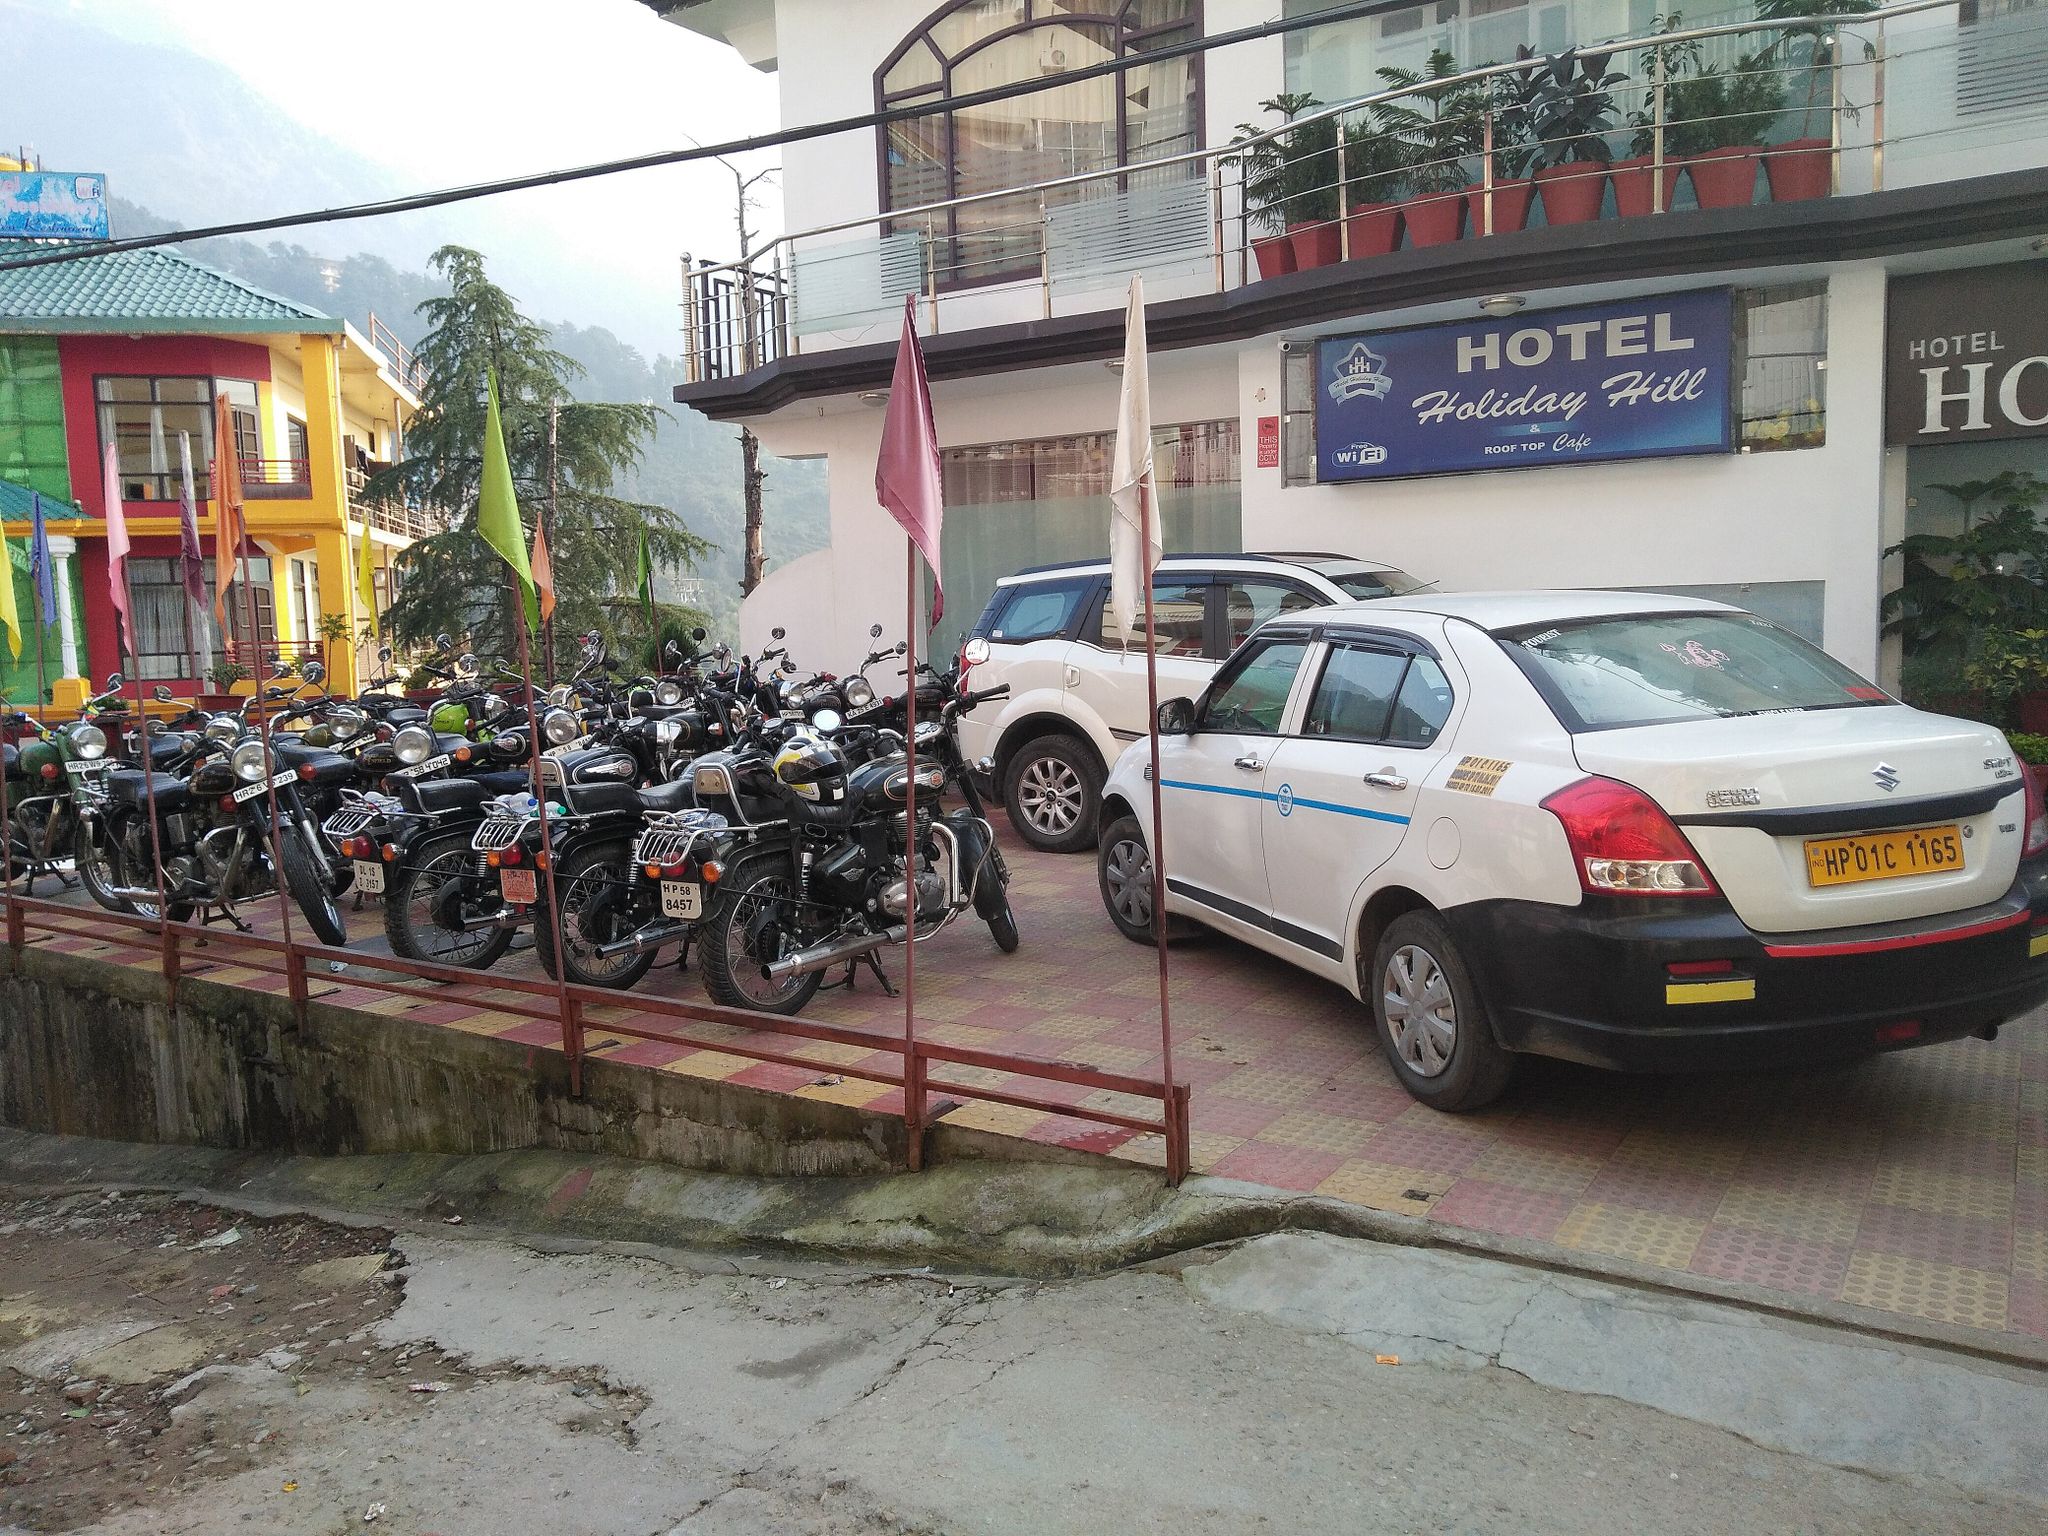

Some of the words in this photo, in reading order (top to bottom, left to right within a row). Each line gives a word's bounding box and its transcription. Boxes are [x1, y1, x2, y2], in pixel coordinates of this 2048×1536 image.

[1457, 313, 1694, 373] HOTEL
[1910, 331, 2005, 360] HOTEL
[1411, 384, 1587, 425] Holiday
[1601, 367, 1707, 407] Hill
[1529, 424, 1541, 433] &
[1484, 444, 1516, 455] ROOF
[1521, 442, 1545, 452] TOP
[1552, 433, 1591, 452] Cafe
[1259, 454, 1277, 462] CCTV
[1523, 628, 1561, 648] TOURIST
[1906, 836, 1957, 867] 1165
[666, 899, 693, 910] 8457
